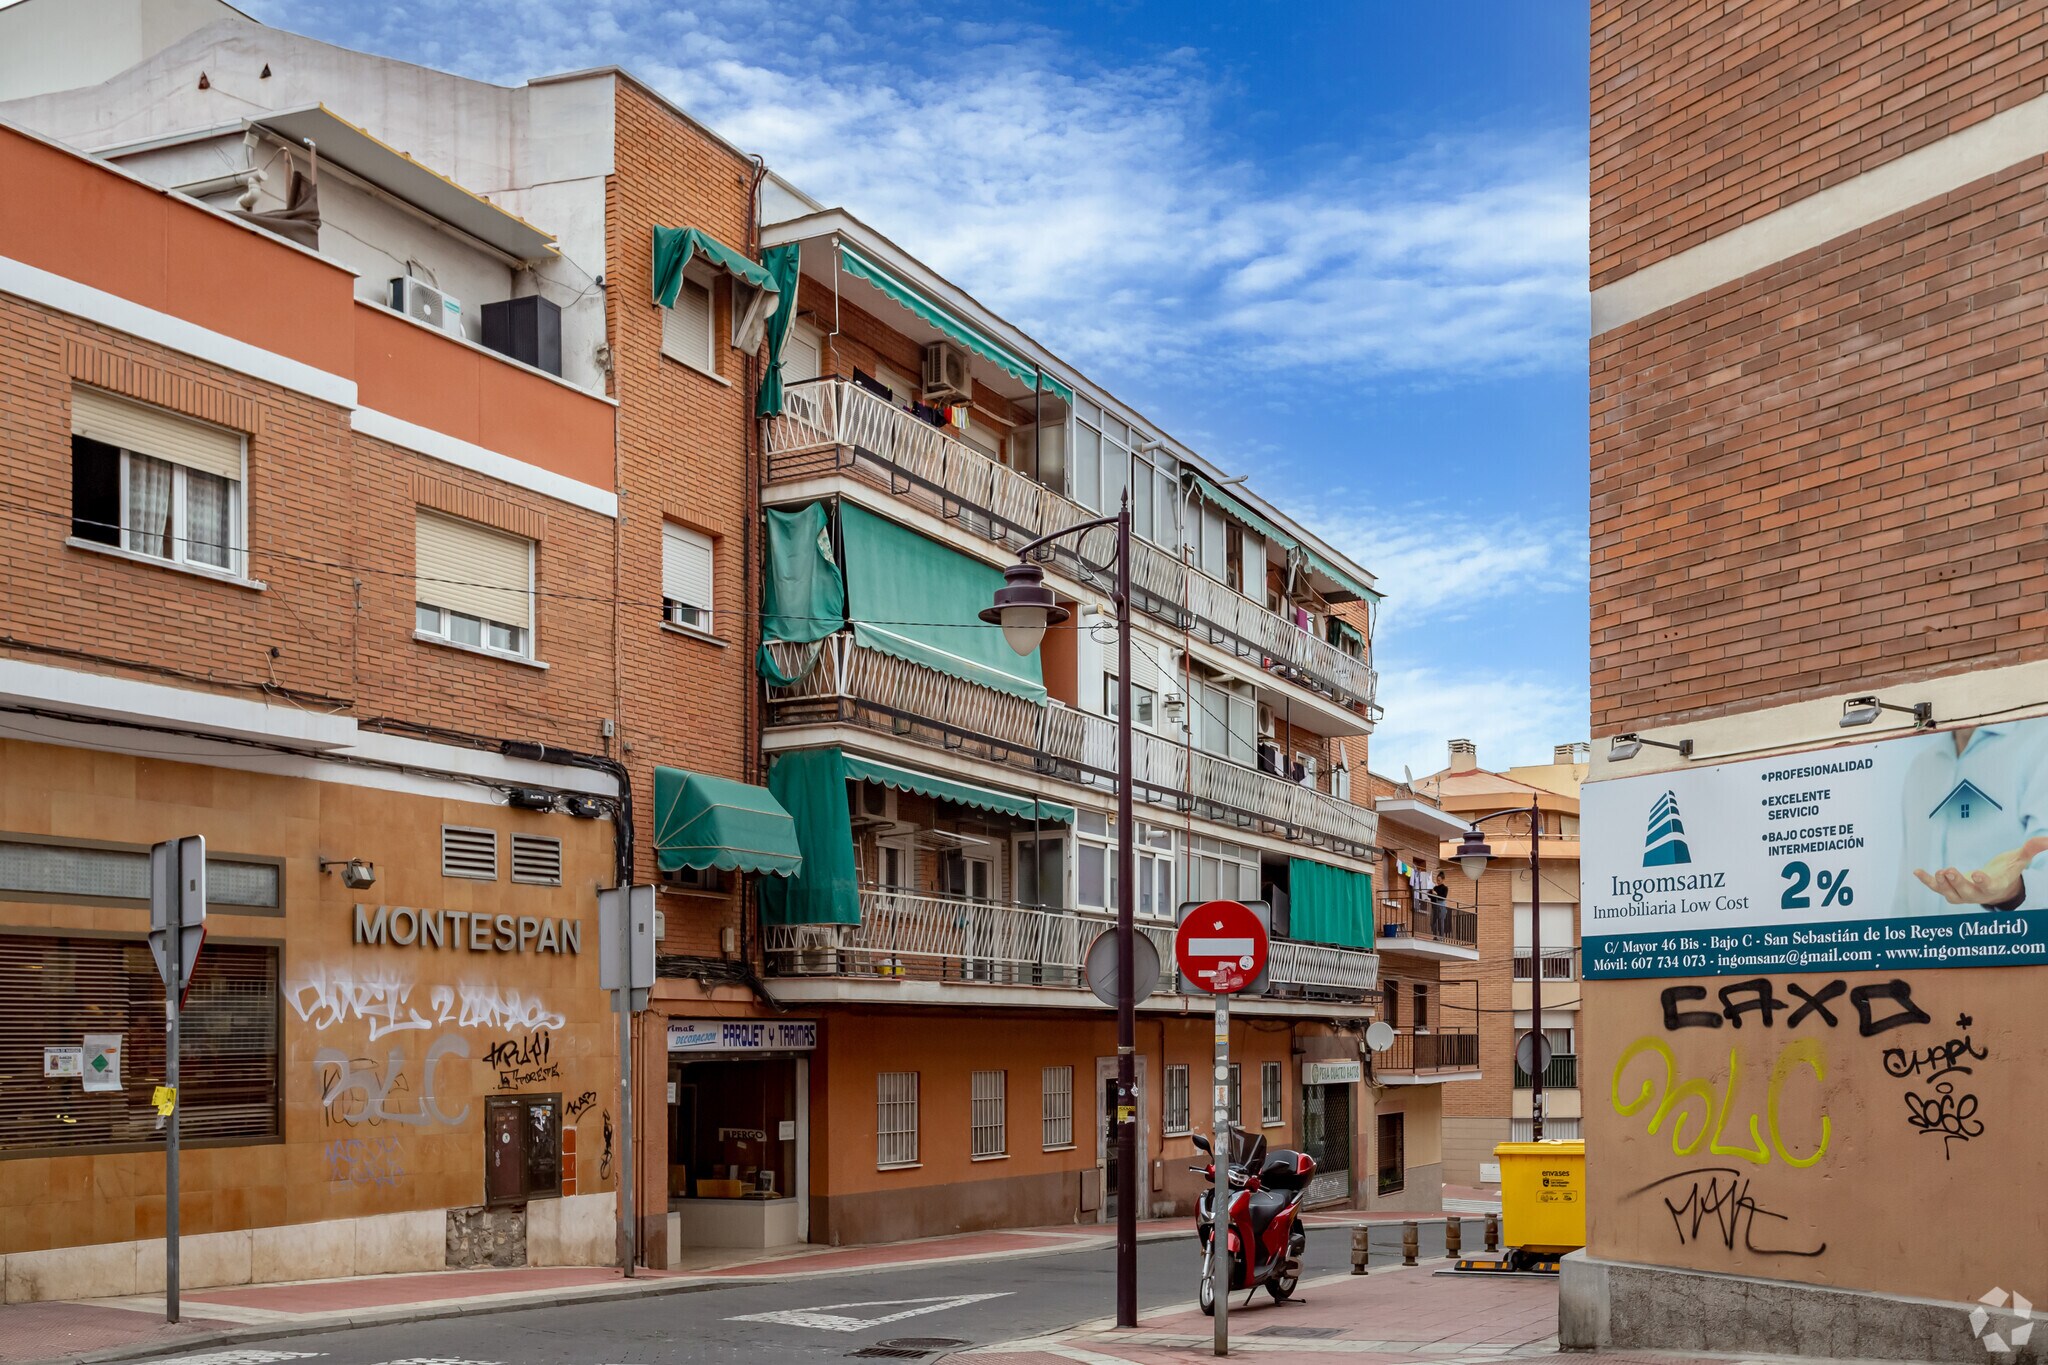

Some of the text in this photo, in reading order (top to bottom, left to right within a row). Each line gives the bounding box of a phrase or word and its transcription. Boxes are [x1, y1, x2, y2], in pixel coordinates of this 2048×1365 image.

[1768, 758, 1873, 782] PROFESIONALIDAD
[1768, 789, 1831, 806] EXCELENTE
[1768, 805, 1819, 820] SERVICIO
[1768, 824, 1854, 842] BAJO COSTE DE
[1768, 835, 1864, 856] INTERMEDIACIÓN
[1611, 871, 1726, 902] Ingomsanz
[1593, 895, 1750, 919] Inmobiliaria Low Cost
[354, 903, 582, 955] MONTESPAN
[1604, 941, 1620, 955] C/
[1622, 940, 1658, 955] Mayor
[1661, 938, 1677, 951] 46
[1680, 937, 1700, 950] Bis
[1710, 935, 1739, 951] Bajo
[1742, 934, 1753, 947] C
[1764, 932, 1788, 946] San
[1792, 928, 1859, 944] Sebastián
[1863, 926, 1880, 941] de
[1885, 926, 1906, 940] los
[1910, 925, 1953, 942] Reyes
[1958, 918, 2028, 940] (Madrid)
[1593, 957, 1627, 971] Móvil:
[1631, 956, 1653, 970] 607
[1657, 955, 1679, 969] 734
[1682, 954, 1706, 968] 073
[1718, 948, 1872, 969] ingomsanz@gmail.com
[1885, 943, 2046, 961] www.ingomsanz.com
[668, 1024, 695, 1032] rimaR
[722, 1024, 815, 1047] PARQUET Y TARIMAS
[731, 1130, 764, 1139] PERGO
